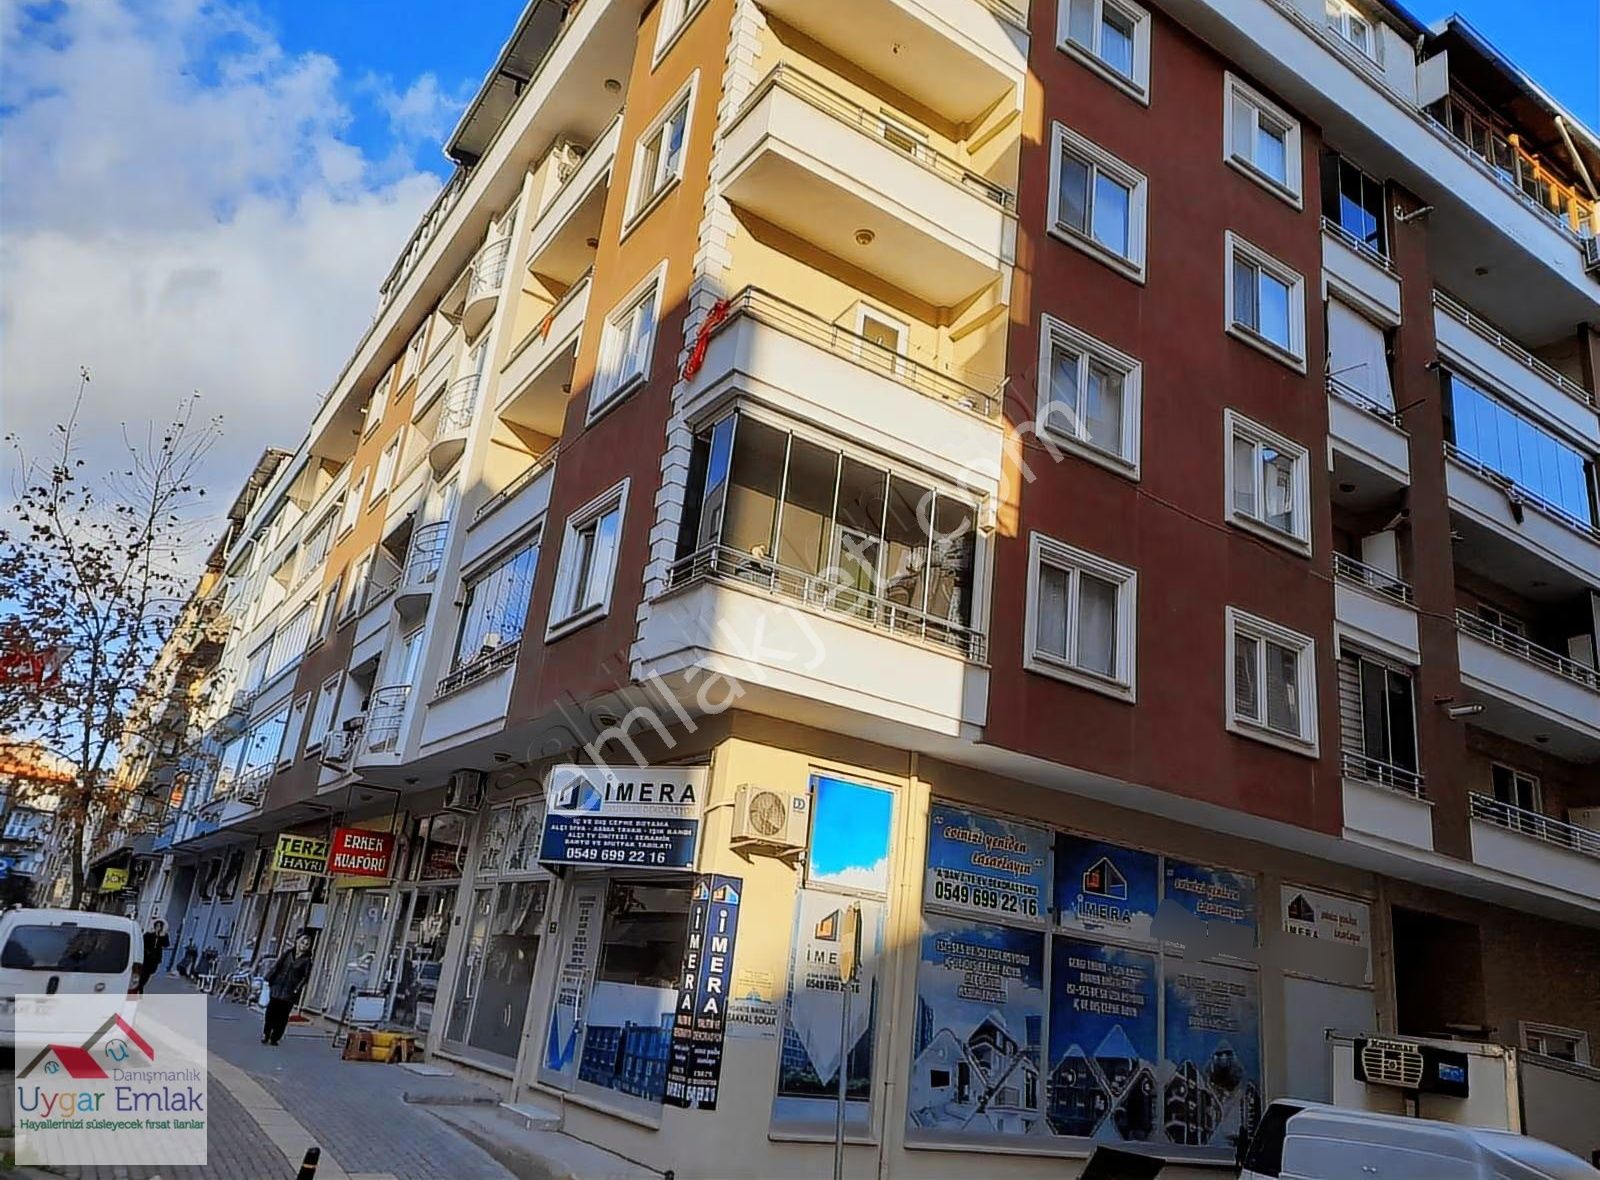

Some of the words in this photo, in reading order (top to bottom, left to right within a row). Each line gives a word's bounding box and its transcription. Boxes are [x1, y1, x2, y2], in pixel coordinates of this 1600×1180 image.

[344, 834, 384, 852] ERKEK
[566, 847, 598, 860] 0549
[601, 849, 625, 862] 699
[628, 850, 645, 863] 22
[650, 851, 666, 864] 16
[935, 881, 969, 903] 0549
[973, 888, 998, 909] 699
[1001, 893, 1018, 913] 22
[1021, 898, 1038, 916] 16
